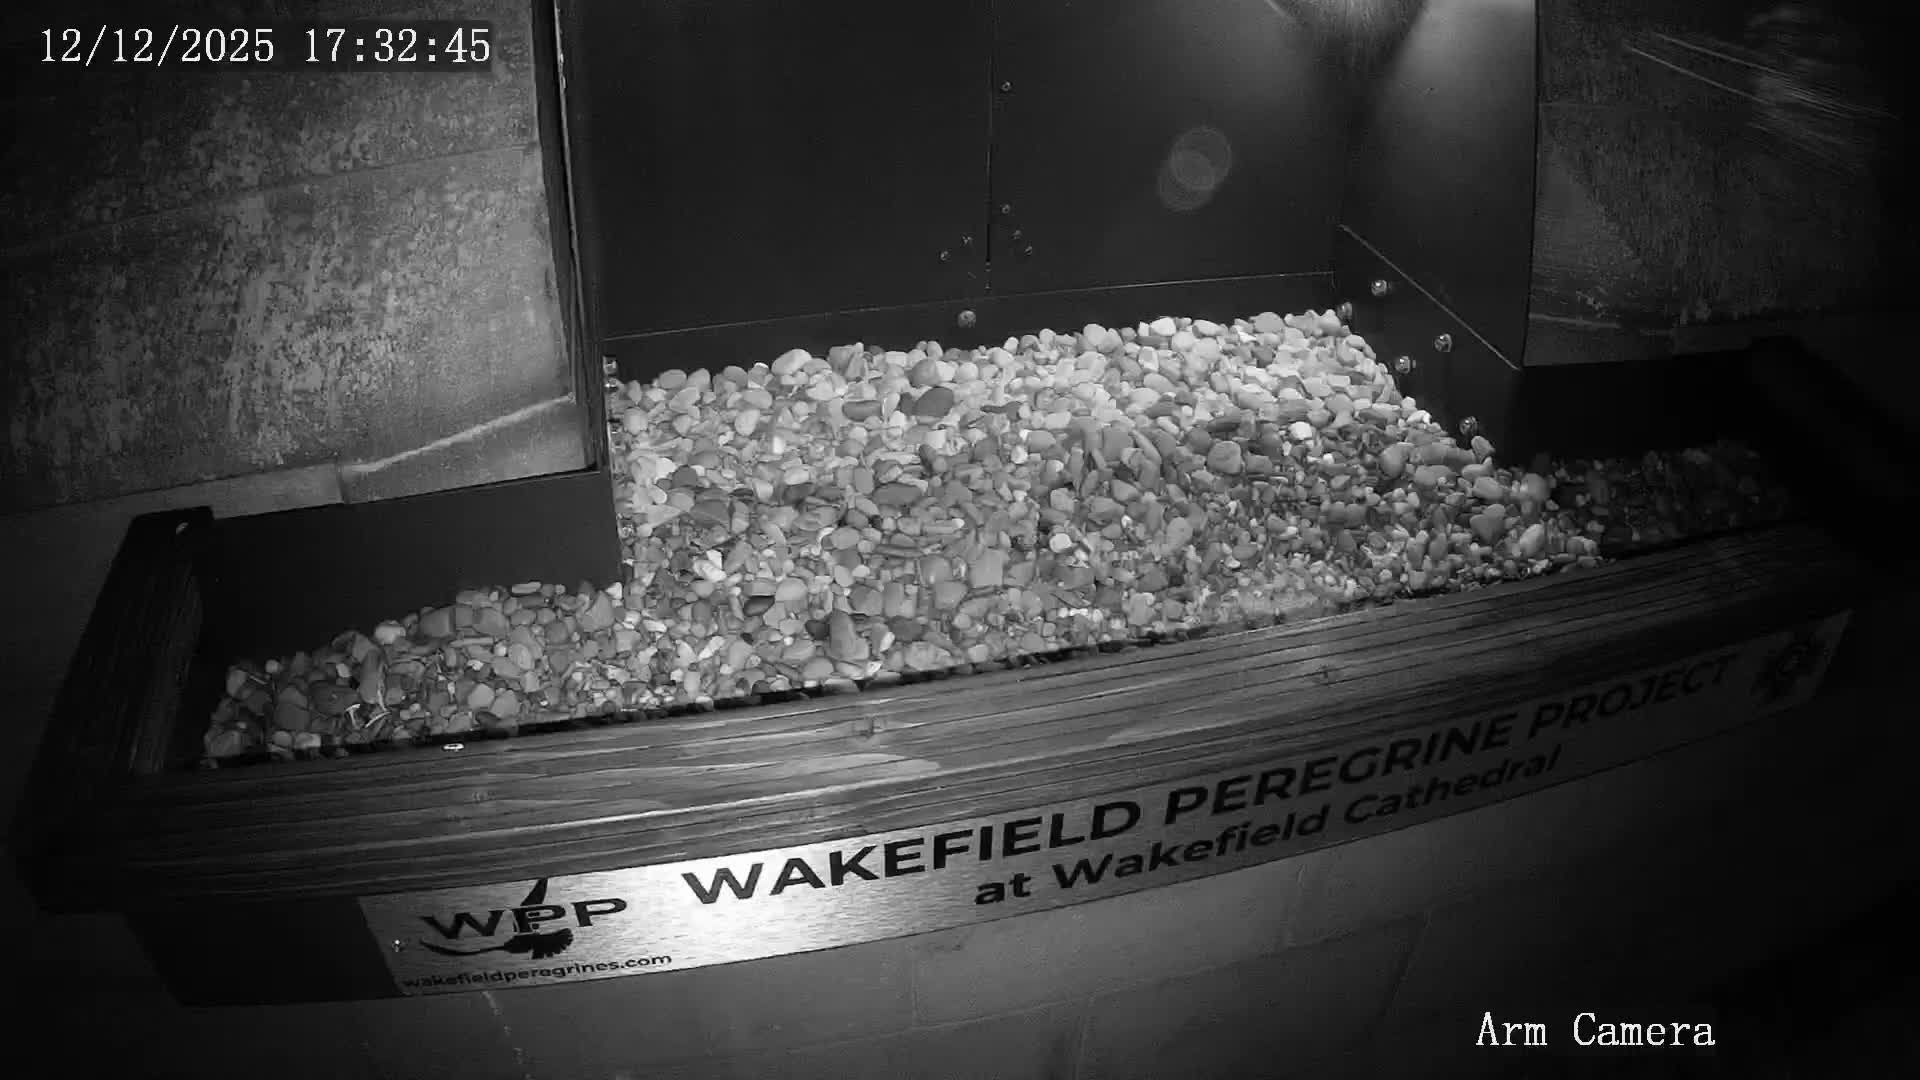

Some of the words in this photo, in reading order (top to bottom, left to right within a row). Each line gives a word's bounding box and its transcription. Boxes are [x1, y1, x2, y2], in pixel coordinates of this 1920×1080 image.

[681, 801, 1140, 905] WAKEFIELD
[1164, 713, 1517, 825] PEREGRINE
[1527, 654, 1738, 739] PROJECT
[975, 872, 1031, 905] at
[1052, 803, 1329, 890] Wakefield
[1344, 743, 1562, 824] Cathedral
[418, 897, 628, 941] WPP
[402, 954, 673, 988] wakefieldperegrines.com
